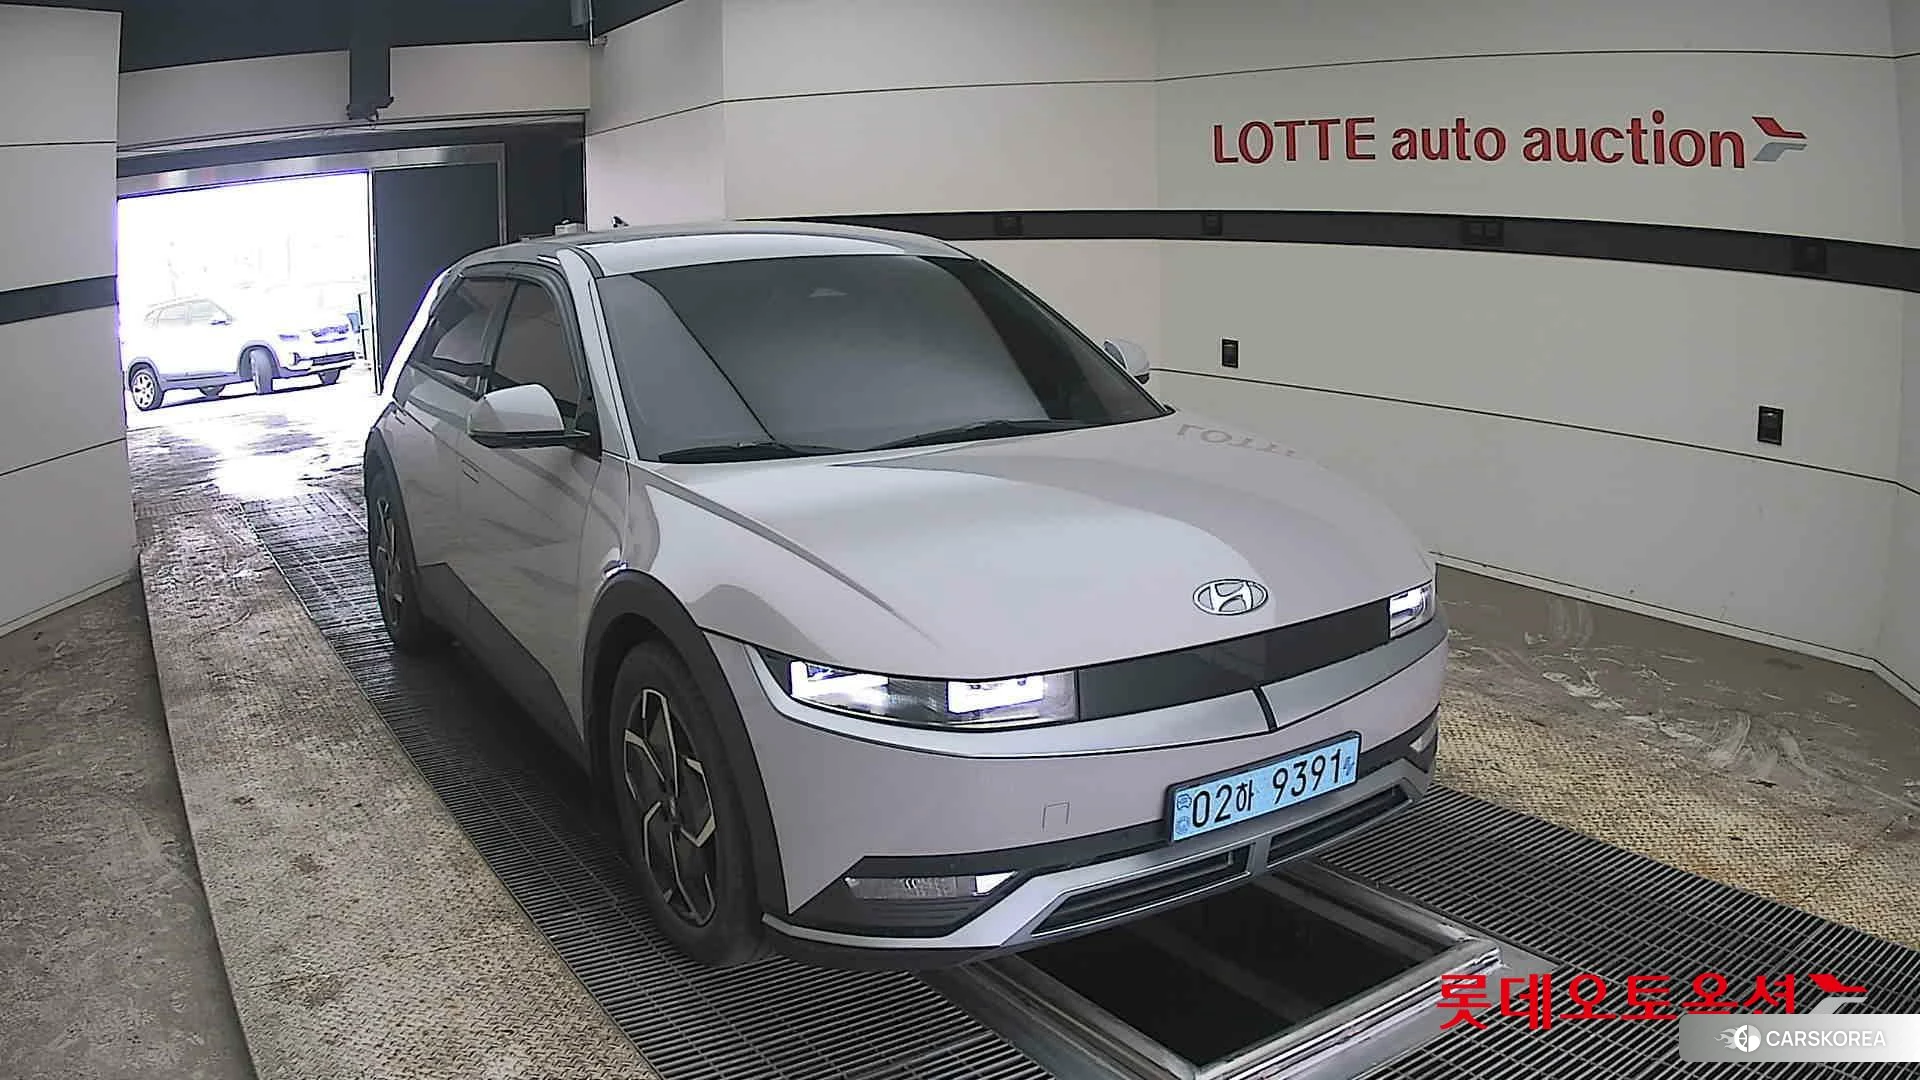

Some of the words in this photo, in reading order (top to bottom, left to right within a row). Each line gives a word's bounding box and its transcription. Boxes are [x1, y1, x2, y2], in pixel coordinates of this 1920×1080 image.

[1213, 117, 1376, 163] LOTTE
[1392, 118, 1507, 161] auto
[1522, 110, 1745, 168] auction
[1192, 779, 1255, 828] 02하
[1272, 748, 1342, 805] 9391
